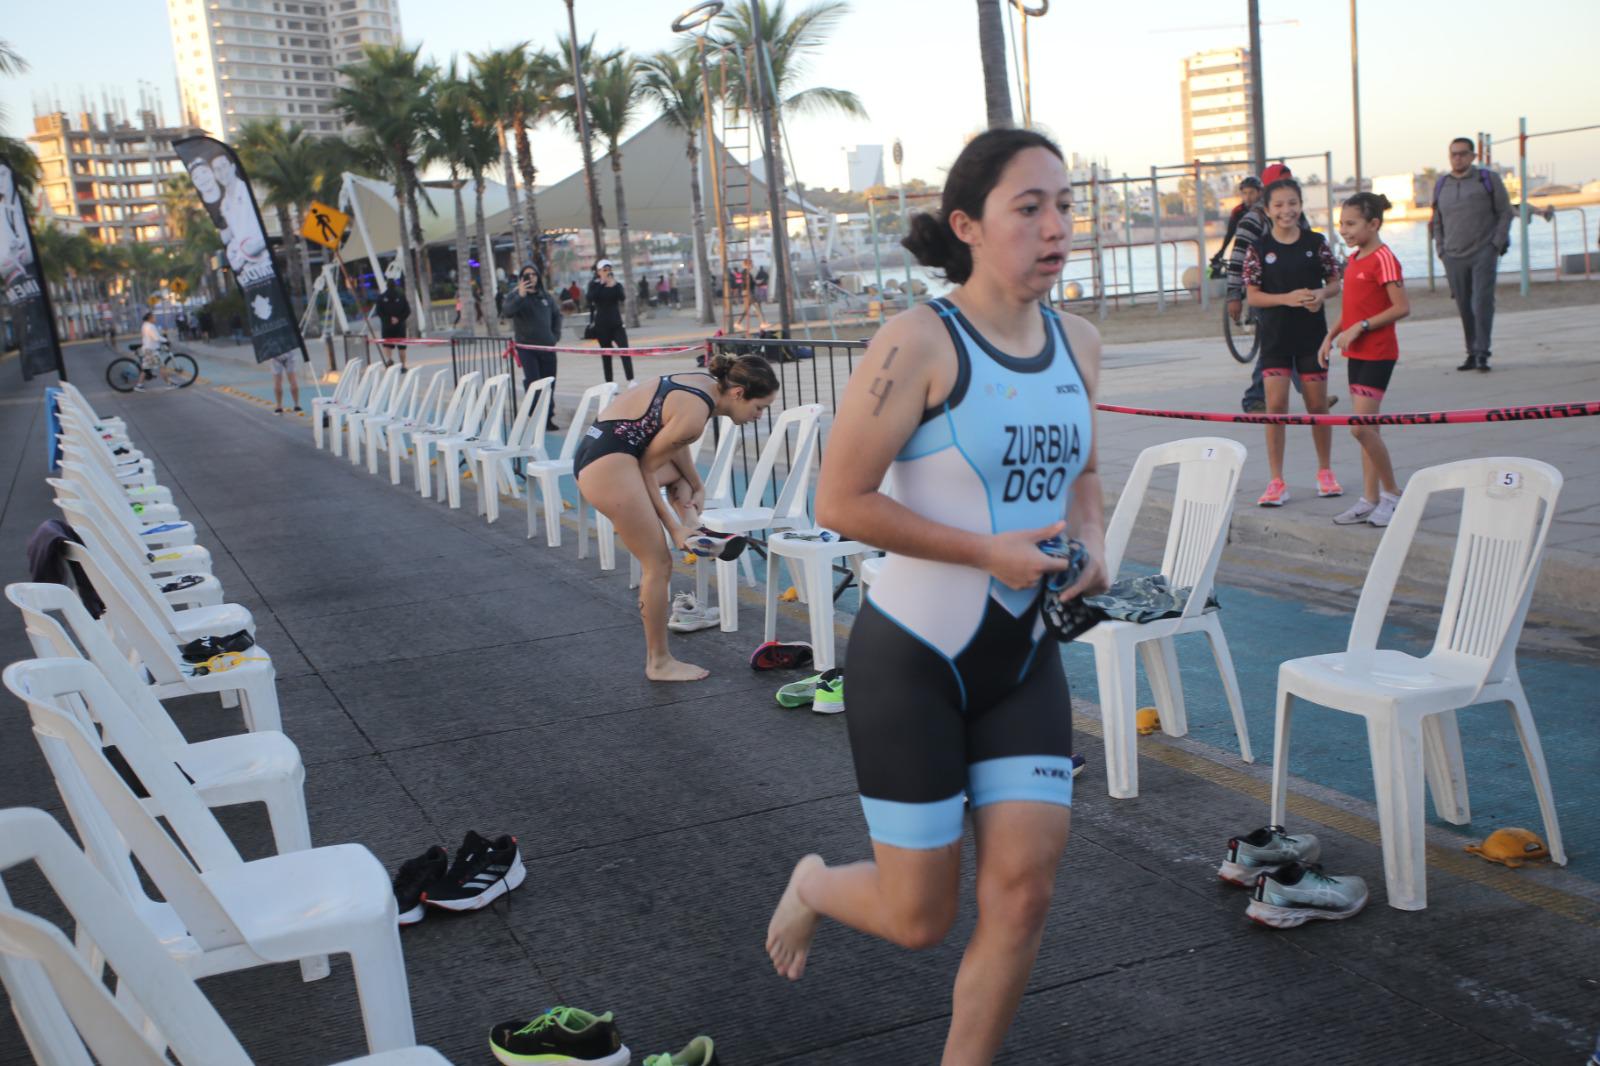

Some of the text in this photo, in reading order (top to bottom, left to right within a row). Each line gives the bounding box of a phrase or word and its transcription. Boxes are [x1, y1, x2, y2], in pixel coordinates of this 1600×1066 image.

[1002, 424, 1080, 466] ZURBIA
[1207, 448, 1214, 457] 7
[1002, 467, 1066, 502] DGO
[1503, 473, 1513, 486] 5
